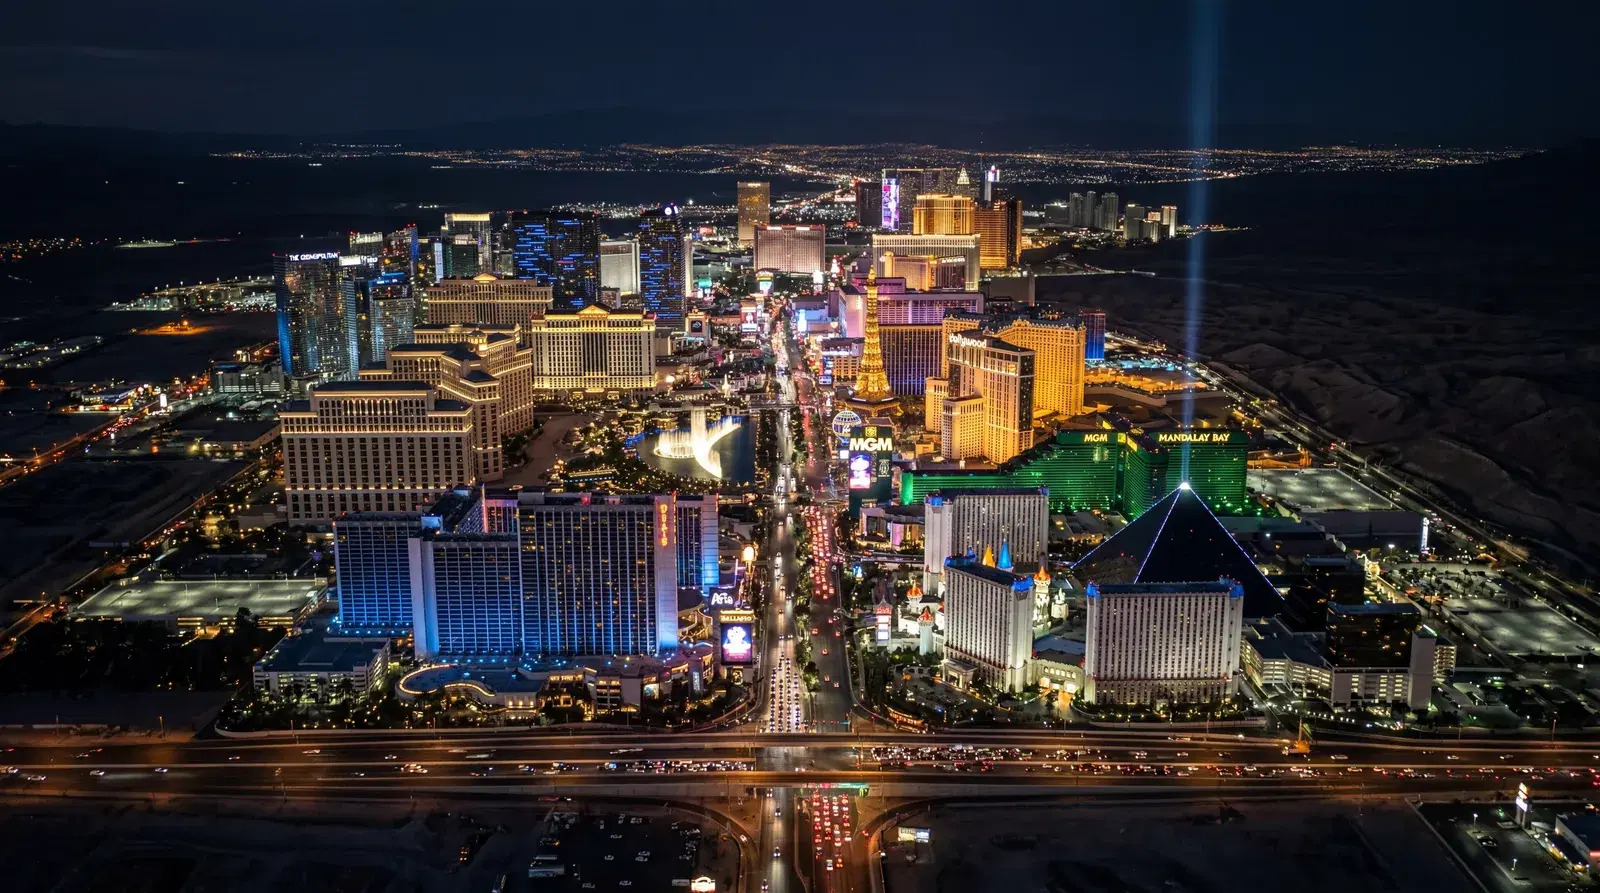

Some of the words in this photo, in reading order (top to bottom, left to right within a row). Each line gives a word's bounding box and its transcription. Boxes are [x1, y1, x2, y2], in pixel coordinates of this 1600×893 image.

[1084, 433, 1108, 442] MGM
[1158, 433, 1210, 442] MANDALAY
[1212, 433, 1230, 442] BAY
[849, 437, 893, 451] MGM
